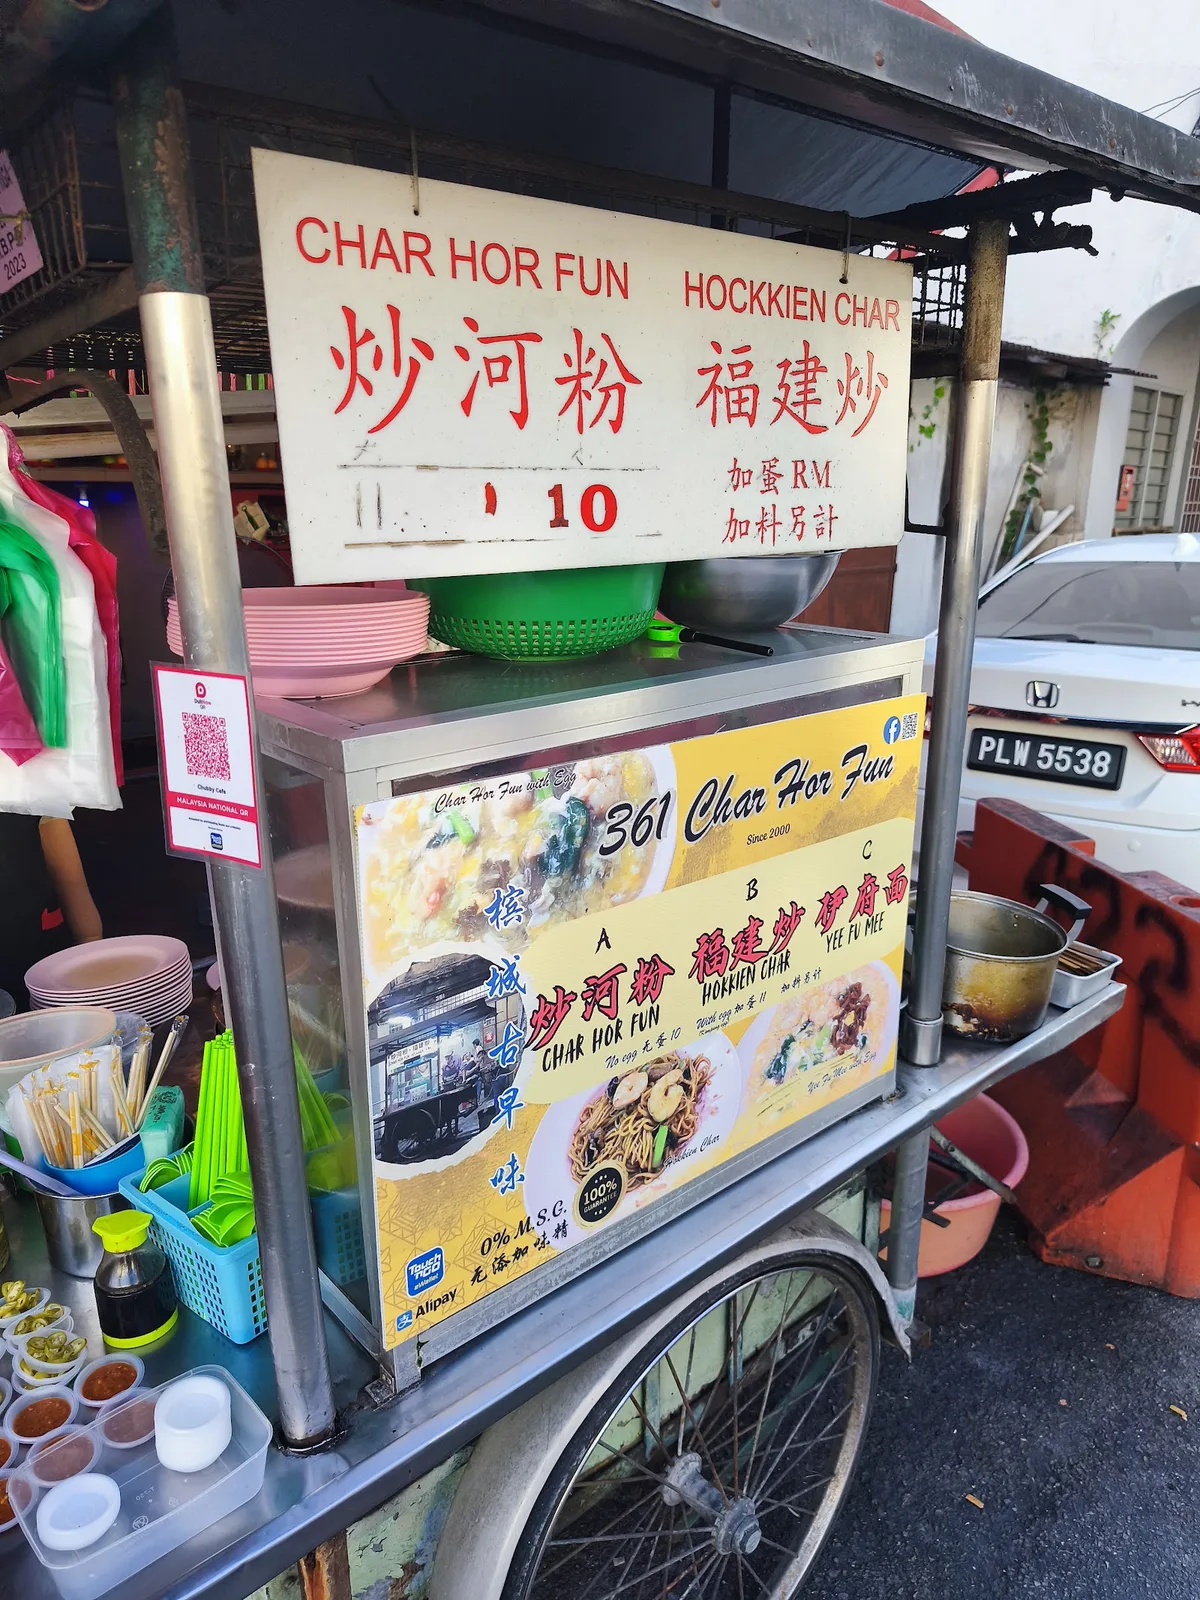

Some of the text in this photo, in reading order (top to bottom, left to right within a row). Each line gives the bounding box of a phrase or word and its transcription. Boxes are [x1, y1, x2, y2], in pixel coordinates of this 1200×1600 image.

[4, 252, 27, 281] 2023
[297, 215, 629, 300] CHAR HOR FUN
[684, 270, 900, 331] HOCKKIEN CHAR
[330, 303, 643, 435] 炒河粉
[696, 339, 889, 438] 福建炒
[727, 456, 833, 496] 加蛋 RM
[548, 483, 618, 533] 10
[978, 735, 1112, 778] PLW 5538
[176, 796, 249, 817] MALAYSIA NATIONAL QR
[197, 783, 227, 795] Chubby Cafe
[434, 769, 577, 814] Char Hor Fun with Egg
[598, 743, 895, 856] 361 Char Hor Fun
[746, 823, 791, 845] Since 2000
[862, 840, 873, 860] C
[745, 878, 759, 901] B
[814, 864, 909, 937] 伊府面
[595, 927, 612, 954] A
[688, 901, 805, 984] 福建炒
[826, 911, 886, 953] YEE FU MEE
[701, 950, 791, 1007] HOKKIEN CHAR
[523, 953, 675, 1051] 炒河粉
[695, 1010, 718, 1030] With
[542, 1004, 660, 1073] CHAR HOR FUN
[604, 1055, 619, 1070] No
[621, 1049, 638, 1065] egg
[670, 1026, 682, 1041] 10
[663, 1134, 720, 1168] Hokkien Char
[583, 1178, 618, 1206] 100%
[583, 1191, 618, 1214] GUARANTEE
[470, 1218, 569, 1287] 无添加味精
[480, 1228, 511, 1257] 0%
[408, 1253, 442, 1276] Touch
[415, 1288, 458, 1320] Alipay
